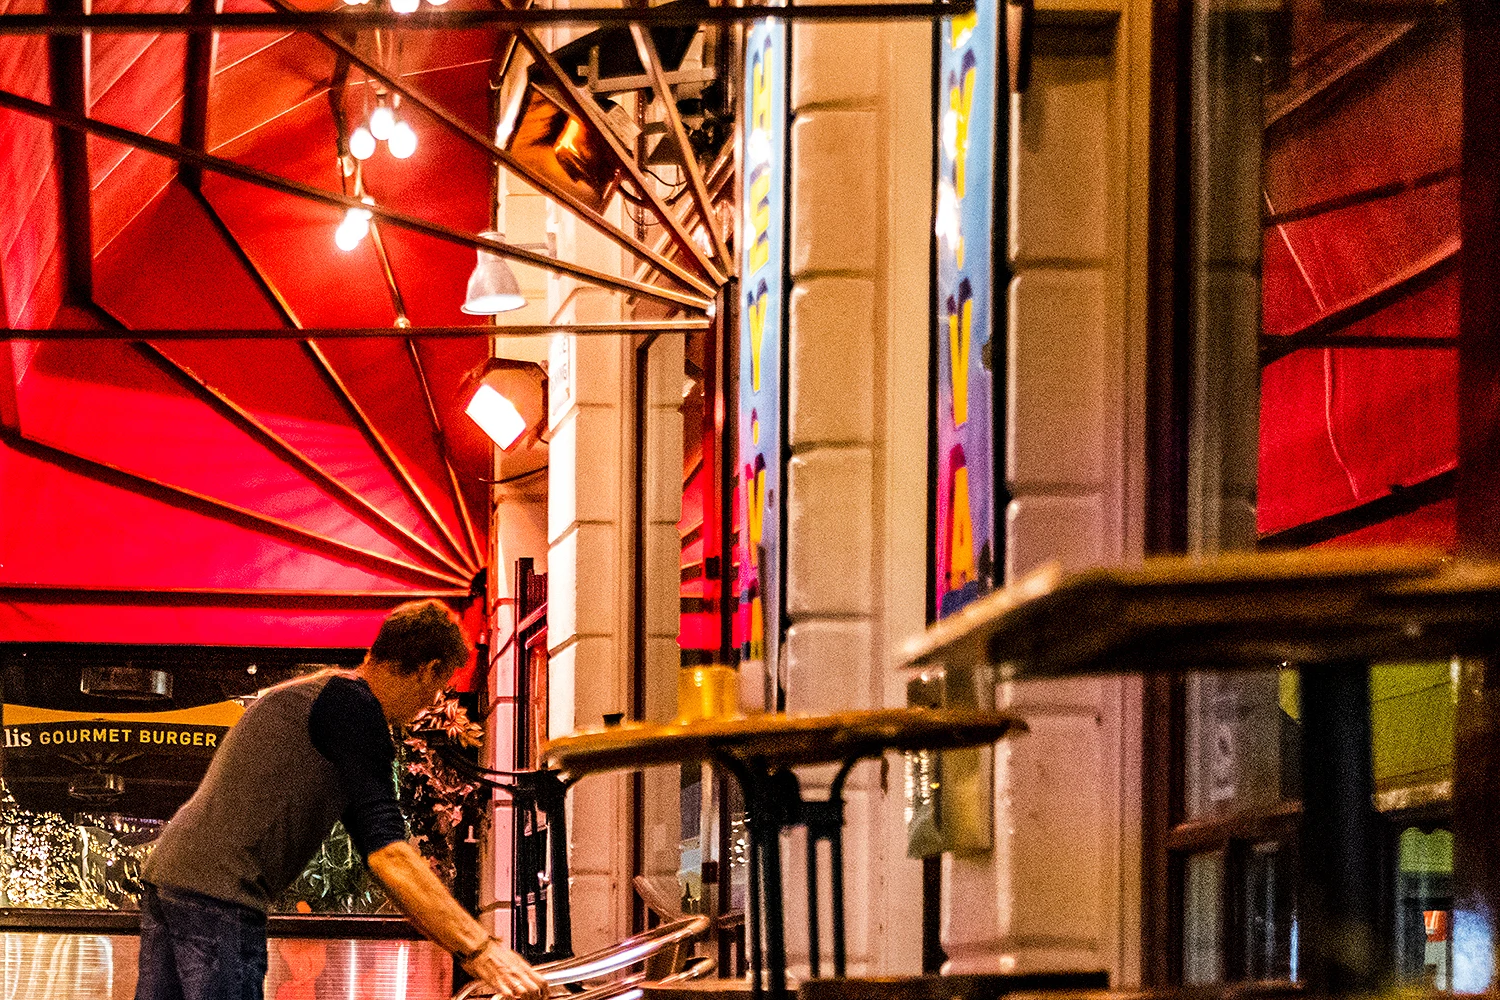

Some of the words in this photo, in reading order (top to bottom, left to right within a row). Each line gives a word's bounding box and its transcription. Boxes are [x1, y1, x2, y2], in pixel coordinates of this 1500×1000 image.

[2, 727, 33, 748] lis
[39, 728, 133, 745] GOURMET
[139, 729, 218, 748] BURGER
